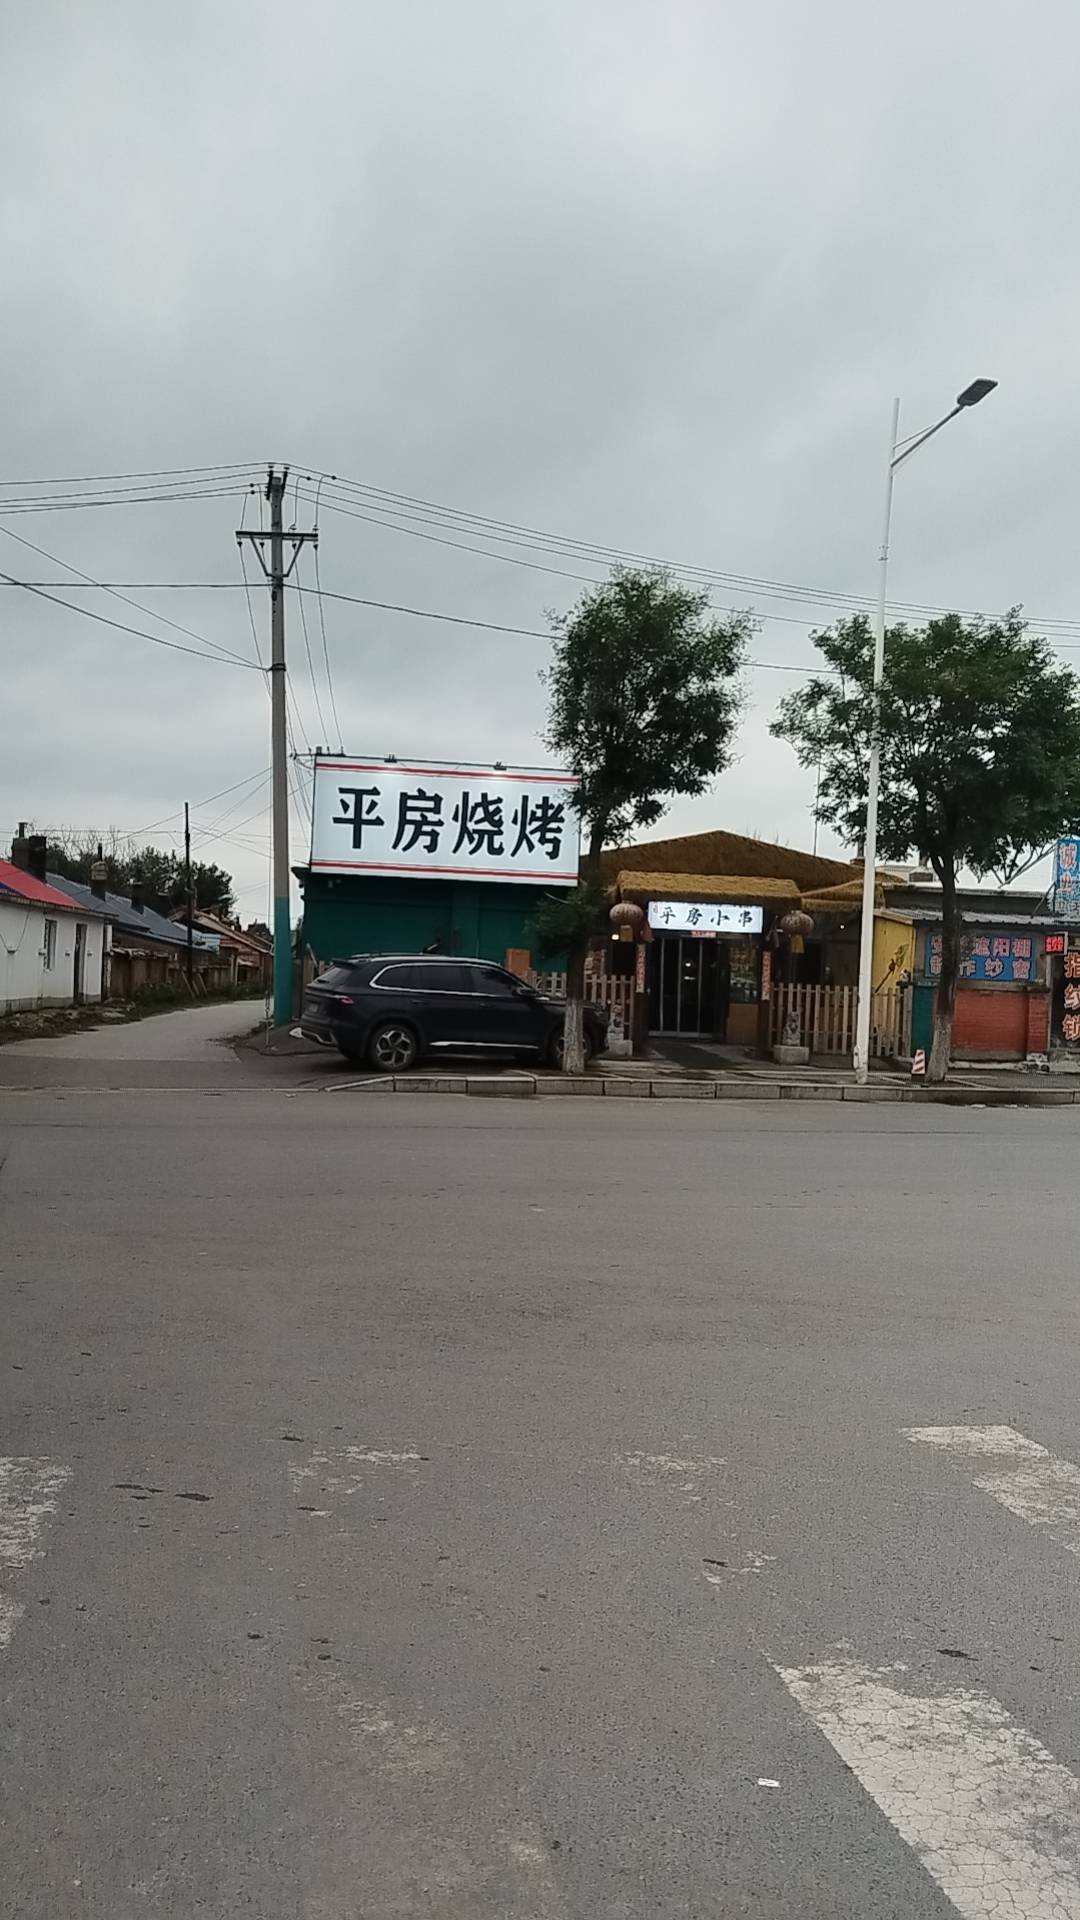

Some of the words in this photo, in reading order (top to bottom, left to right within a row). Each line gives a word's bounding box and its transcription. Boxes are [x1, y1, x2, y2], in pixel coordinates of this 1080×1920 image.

[333, 786, 564, 859] 平房烧烤
[660, 906, 753, 927] 平房小串
